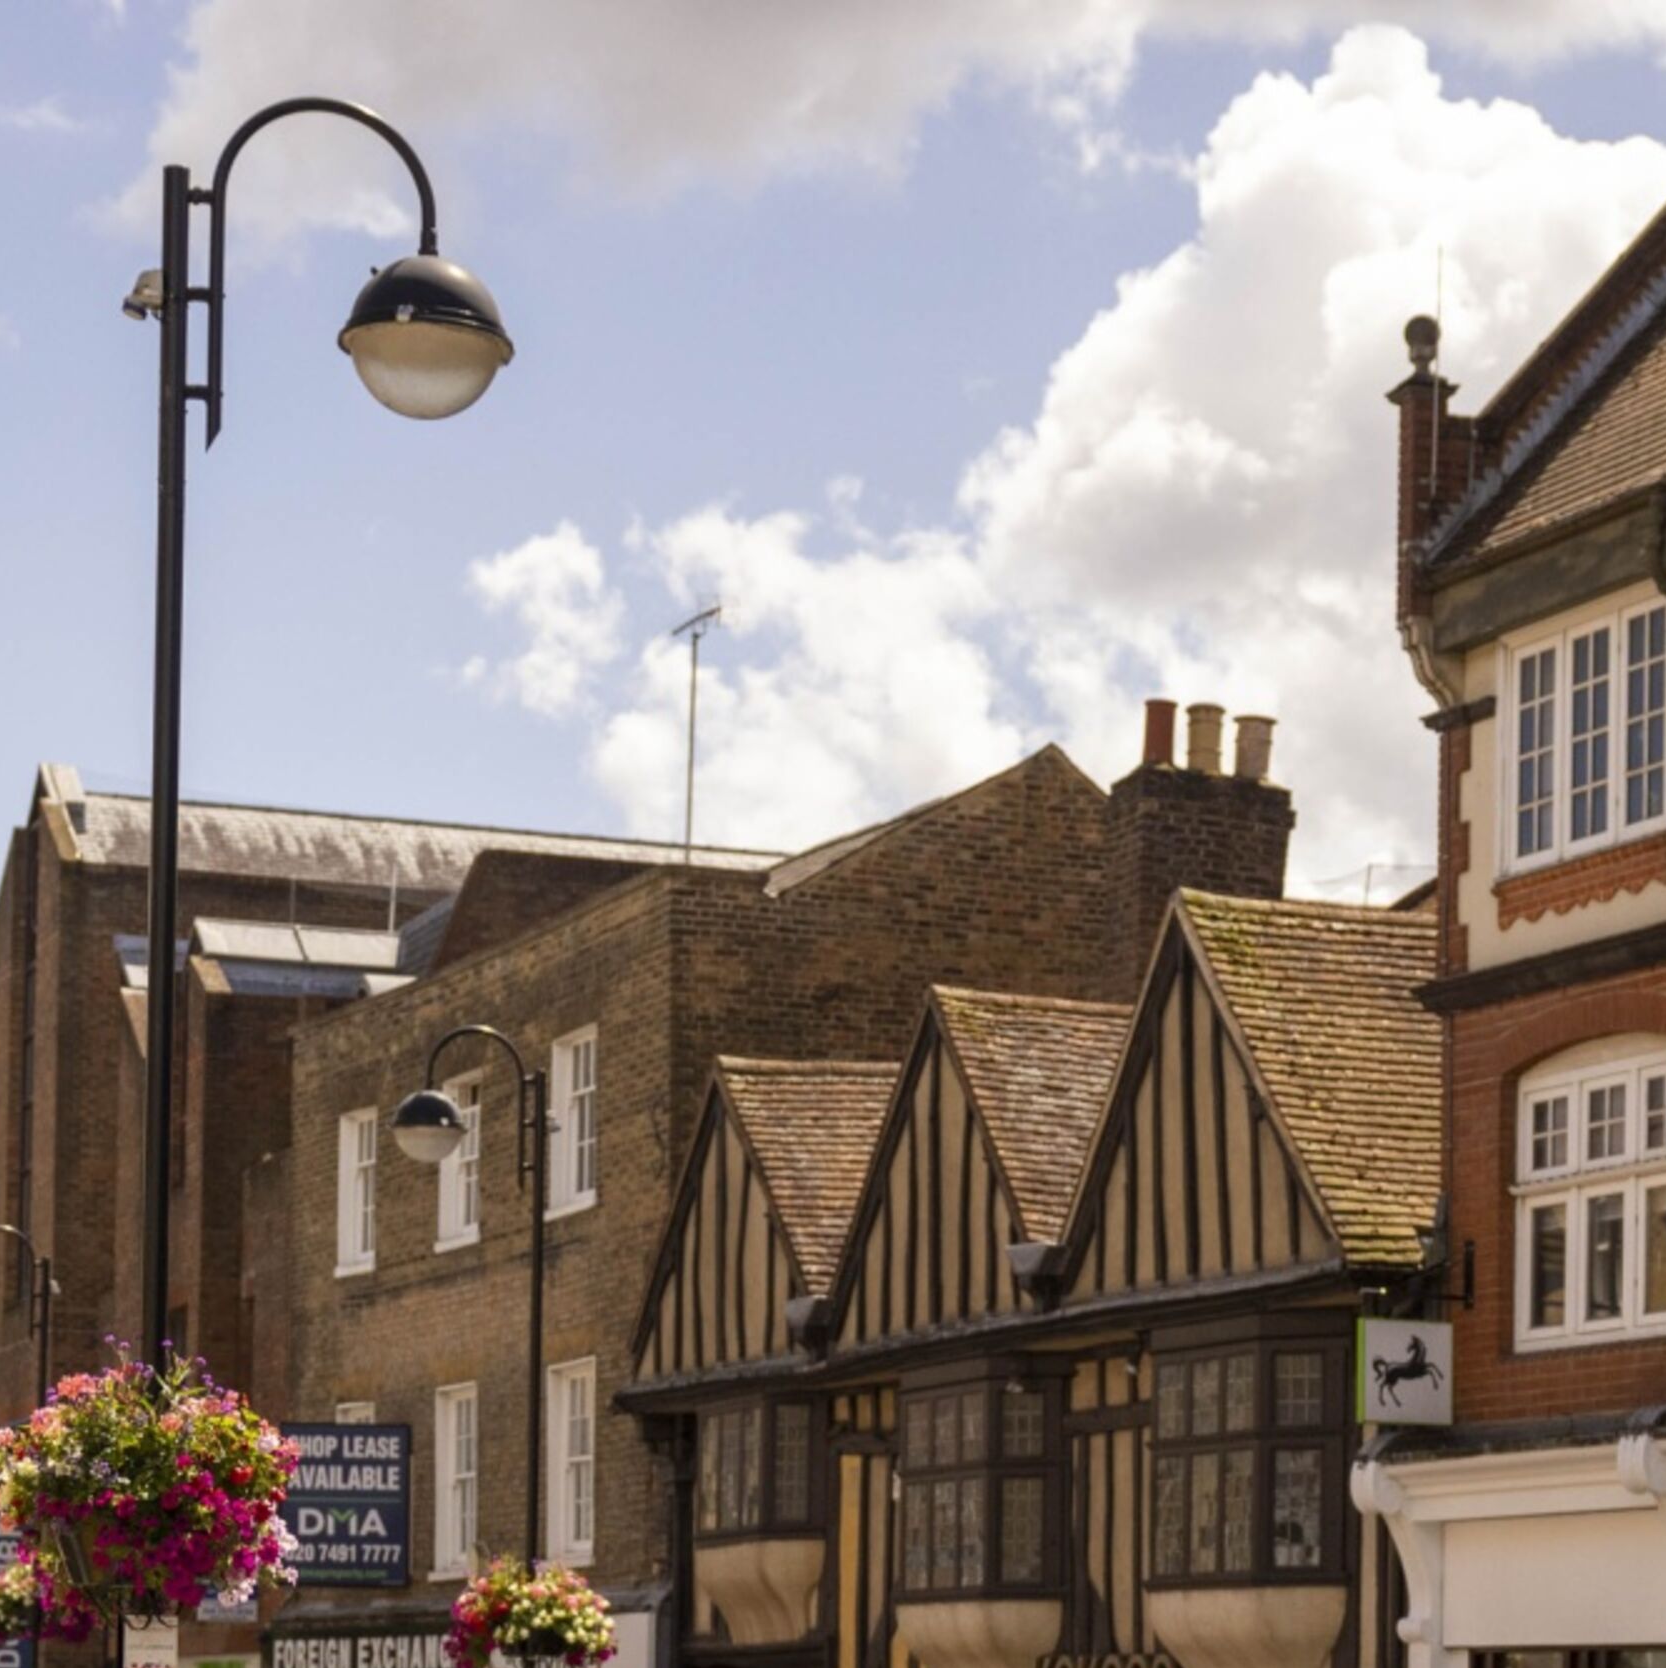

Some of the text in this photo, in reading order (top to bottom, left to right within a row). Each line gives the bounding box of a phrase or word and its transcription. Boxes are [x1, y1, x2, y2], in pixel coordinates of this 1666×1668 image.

[343, 1436, 400, 1459] LEASE
[288, 1465, 400, 1490] AVAILABLE
[298, 1508, 387, 1536] DMA
[318, 1545, 357, 1562] 7491
[362, 1545, 401, 1562] 7777
